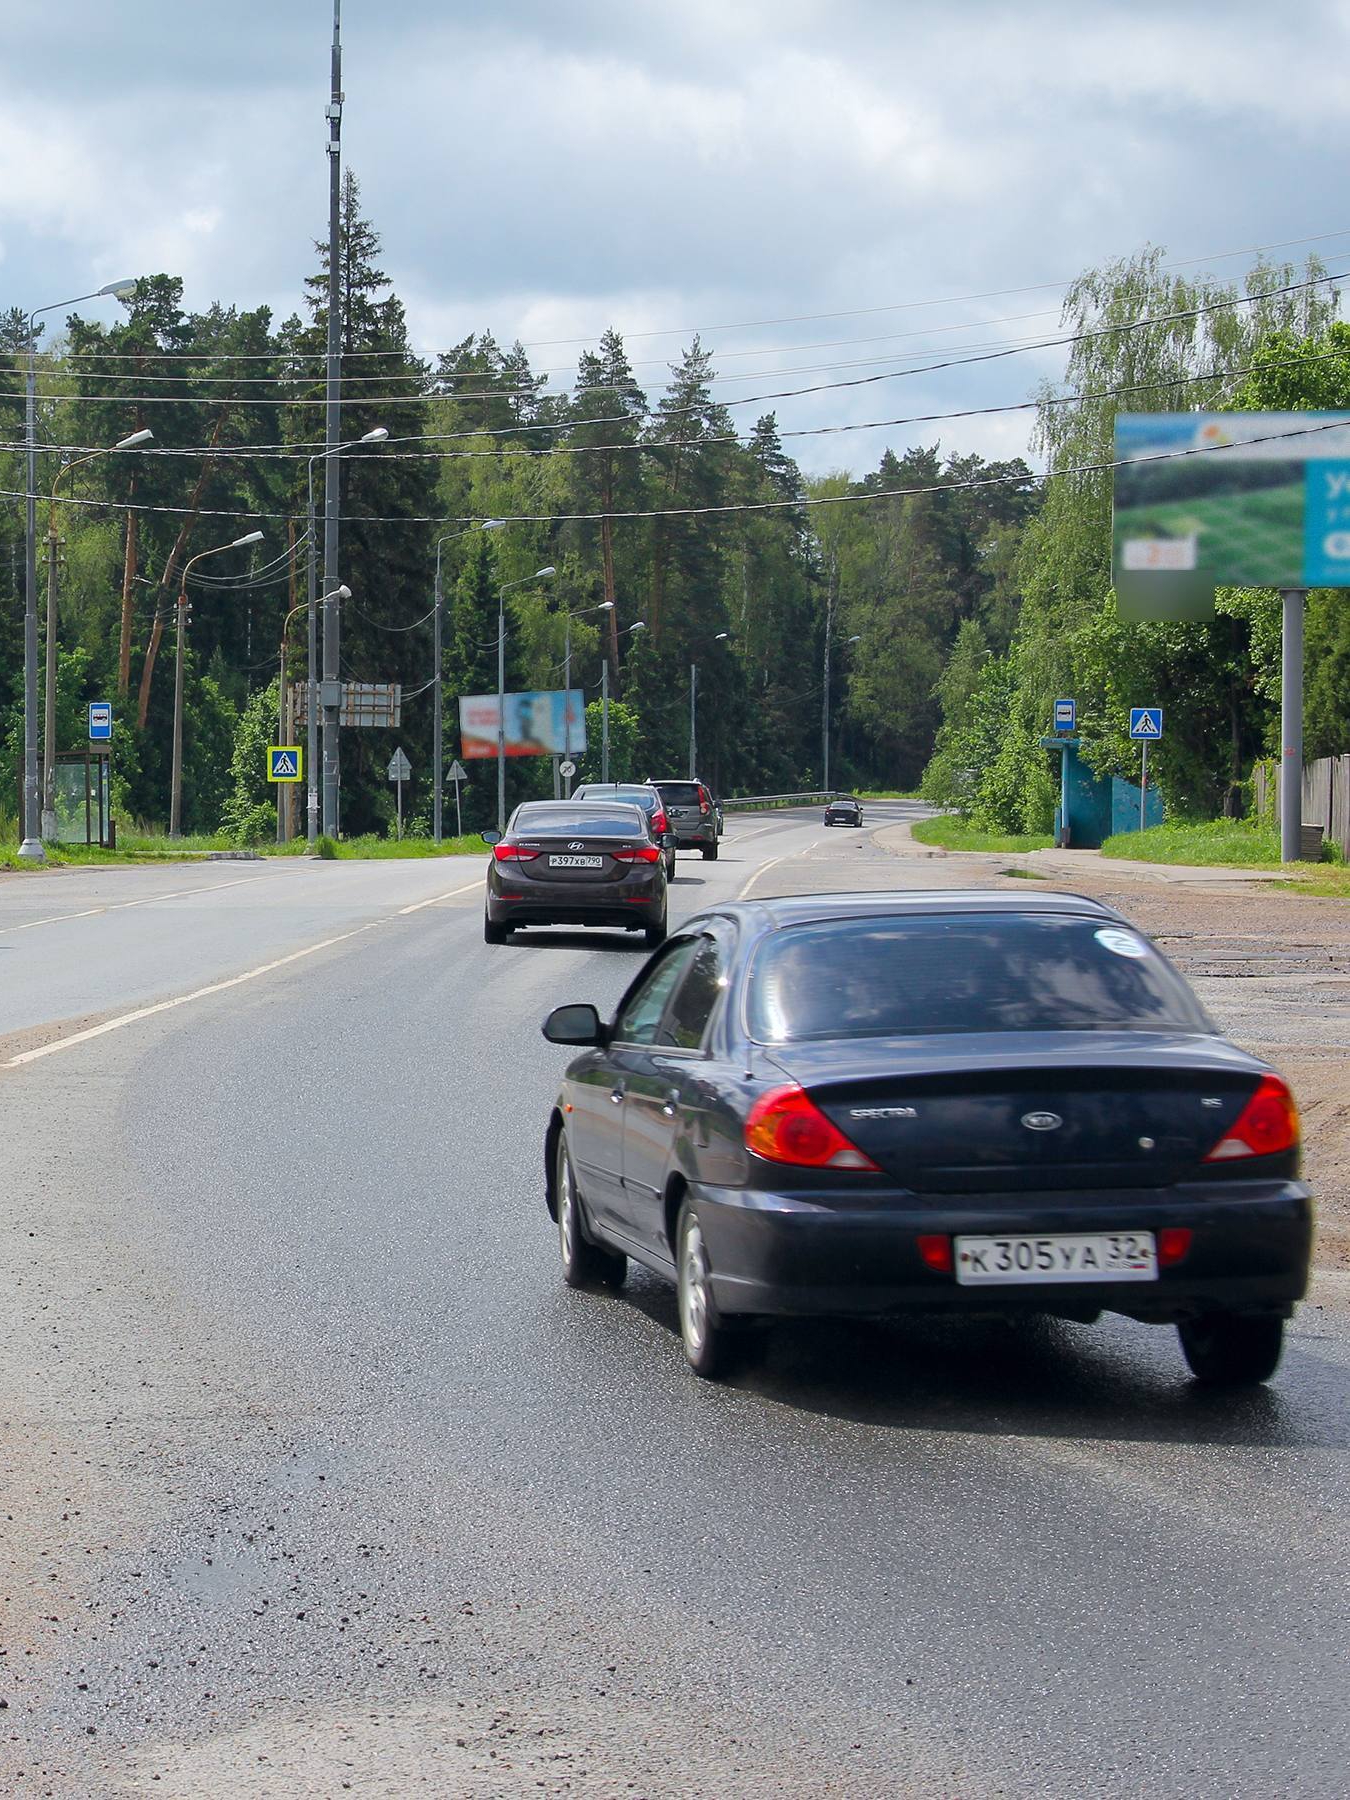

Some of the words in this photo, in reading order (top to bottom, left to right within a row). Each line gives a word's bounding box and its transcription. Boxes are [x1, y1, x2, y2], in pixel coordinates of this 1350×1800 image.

[551, 856, 586, 866] Р397ХВ
[587, 856, 601, 864] 790
[969, 1240, 1100, 1273] К305УА
[1106, 1237, 1139, 1260] 32
